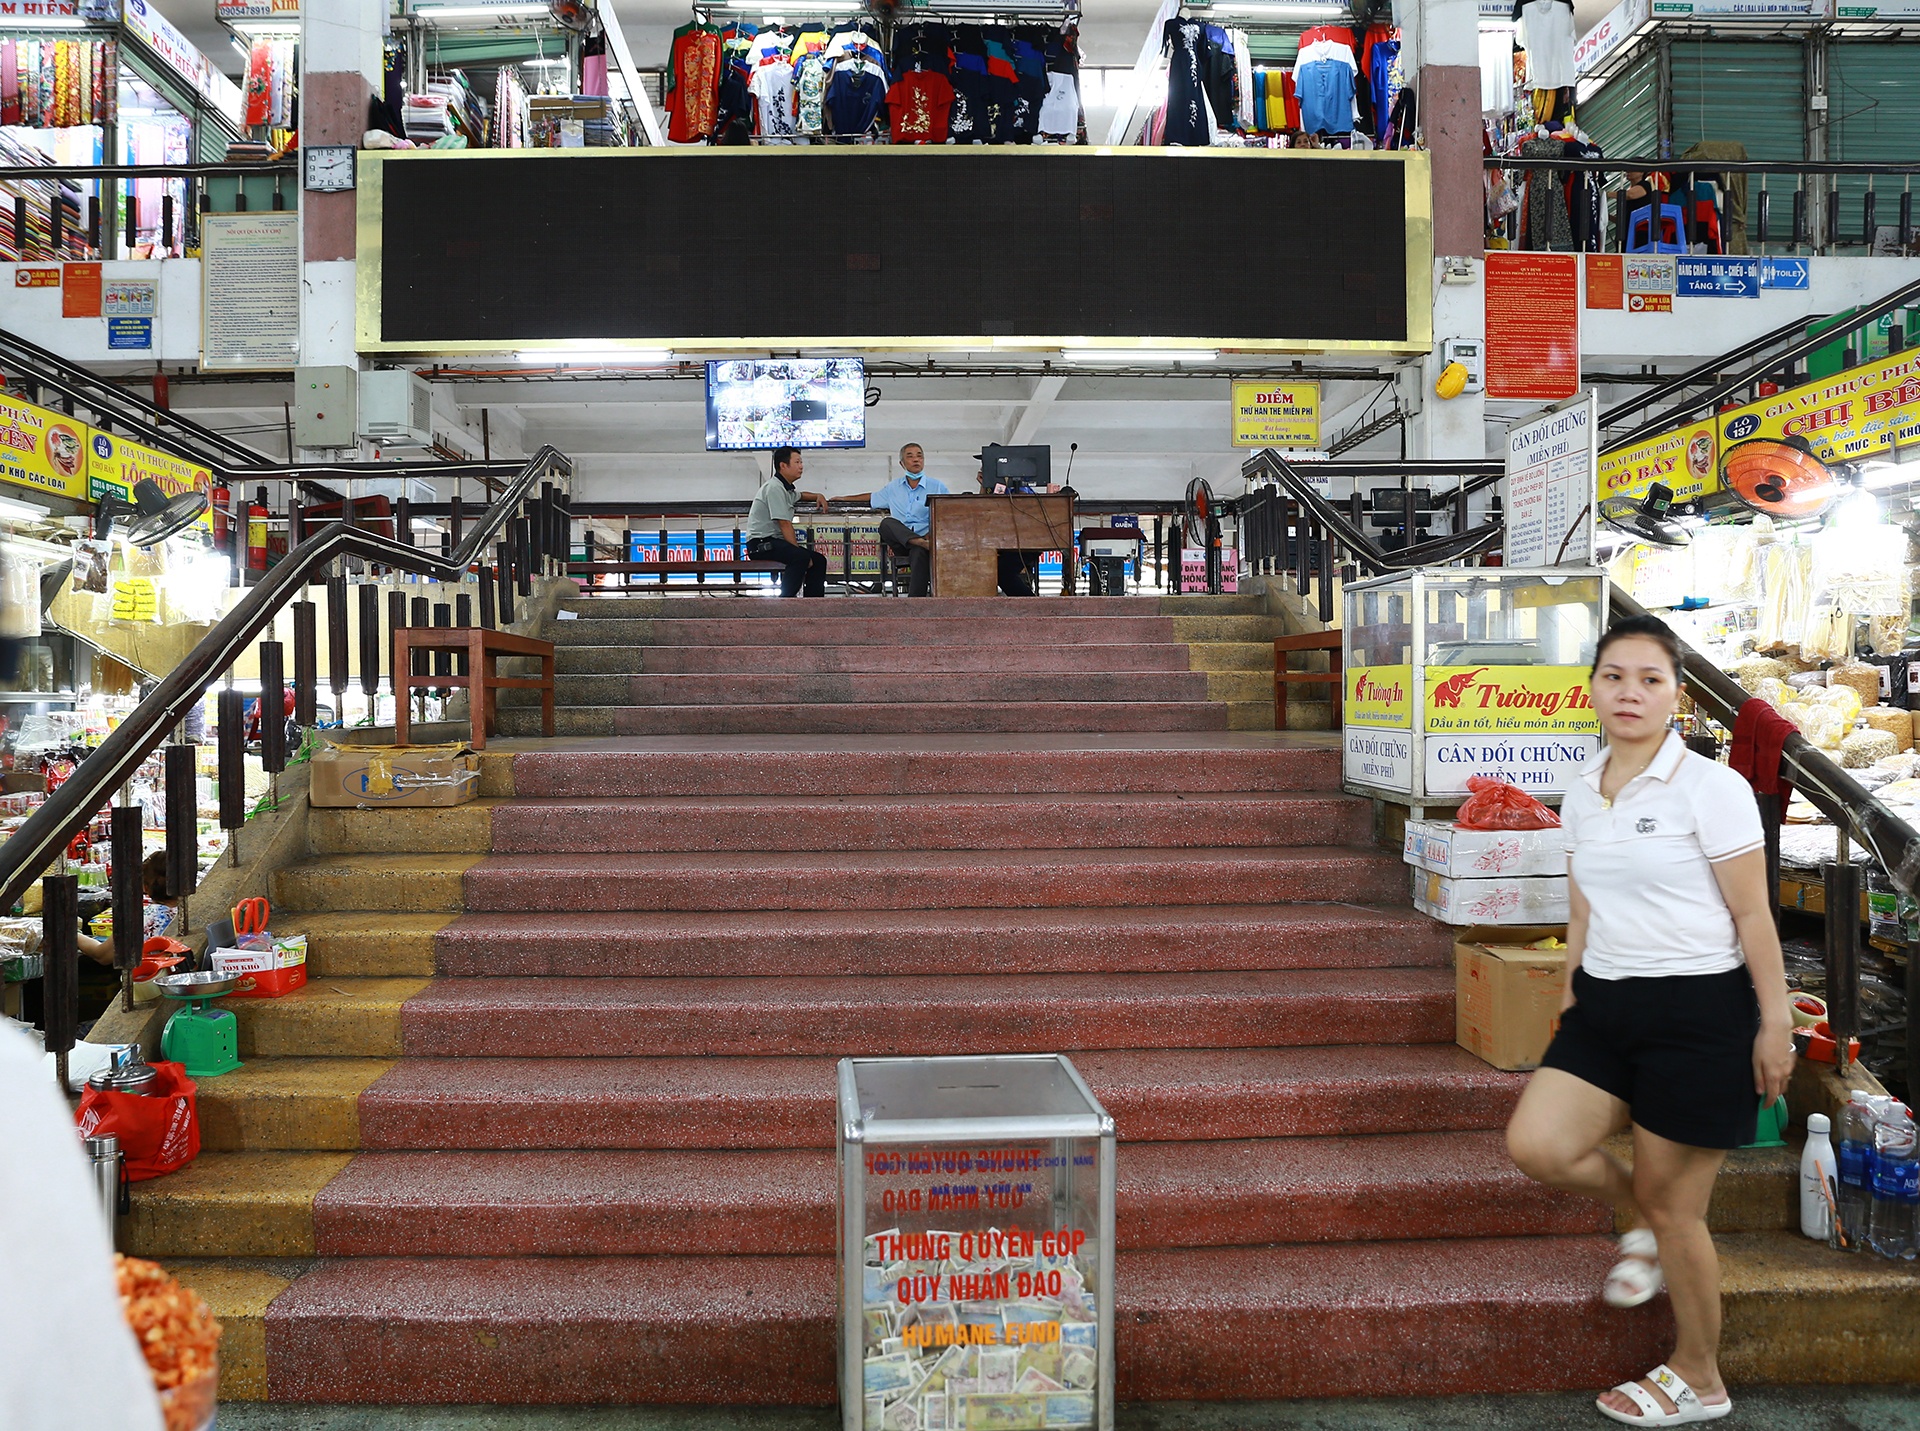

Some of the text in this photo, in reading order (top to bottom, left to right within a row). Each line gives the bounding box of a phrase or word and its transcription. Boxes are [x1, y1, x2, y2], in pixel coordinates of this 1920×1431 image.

[220, 6, 270, 15] 0905478919
[152, 31, 173, 61] KIM
[1776, 269, 1801, 277] TOILET
[1256, 387, 1294, 404] ĐIỂM
[1765, 373, 1876, 418] GIA VỊ THỰC
[1734, 416, 1750, 429] LÔ
[1781, 400, 1853, 438] CHỊ
[1832, 411, 1917, 443] bán đặc sản:
[1512, 410, 1586, 452] CÂN ĐỐI CHỨNG
[1732, 425, 1752, 438] 137
[97, 445, 108, 458] 151
[1526, 438, 1569, 466] (MIỄN PHÍ)
[1600, 435, 1685, 472] GIA VỊ THỰC PHẨM
[1821, 445, 1835, 459] CÁ
[1845, 436, 1869, 453] MỰC
[91, 460, 103, 473] CHỢ
[120, 445, 192, 478] GIA VỊ THỰC PHẨM
[1607, 467, 1632, 489] CÔ
[1636, 455, 1678, 480] BẢY
[29, 472, 45, 484] CÁC
[47, 477, 66, 490] LOẠI
[1676, 482, 1703, 497] CÁC LOẠI
[1430, 715, 1599, 731] Dầu ăn tốt, hiểu món ăn ngon!
[1349, 734, 1407, 759] CÂN ĐỐI CHỨNG
[1437, 740, 1586, 763] CÂN ĐỐI CHỨNG
[1361, 758, 1395, 779] (MIỄN PHÍ)
[1522, 768, 1555, 785] PHÍ)
[931, 1186, 949, 1195] BAN
[959, 1224, 1035, 1263] QUYÊN
[1041, 1224, 1086, 1256] GÓP
[897, 1267, 1061, 1306] QŨY NHÂN ĐẠO
[902, 1320, 1061, 1348] HUMANE FUND
